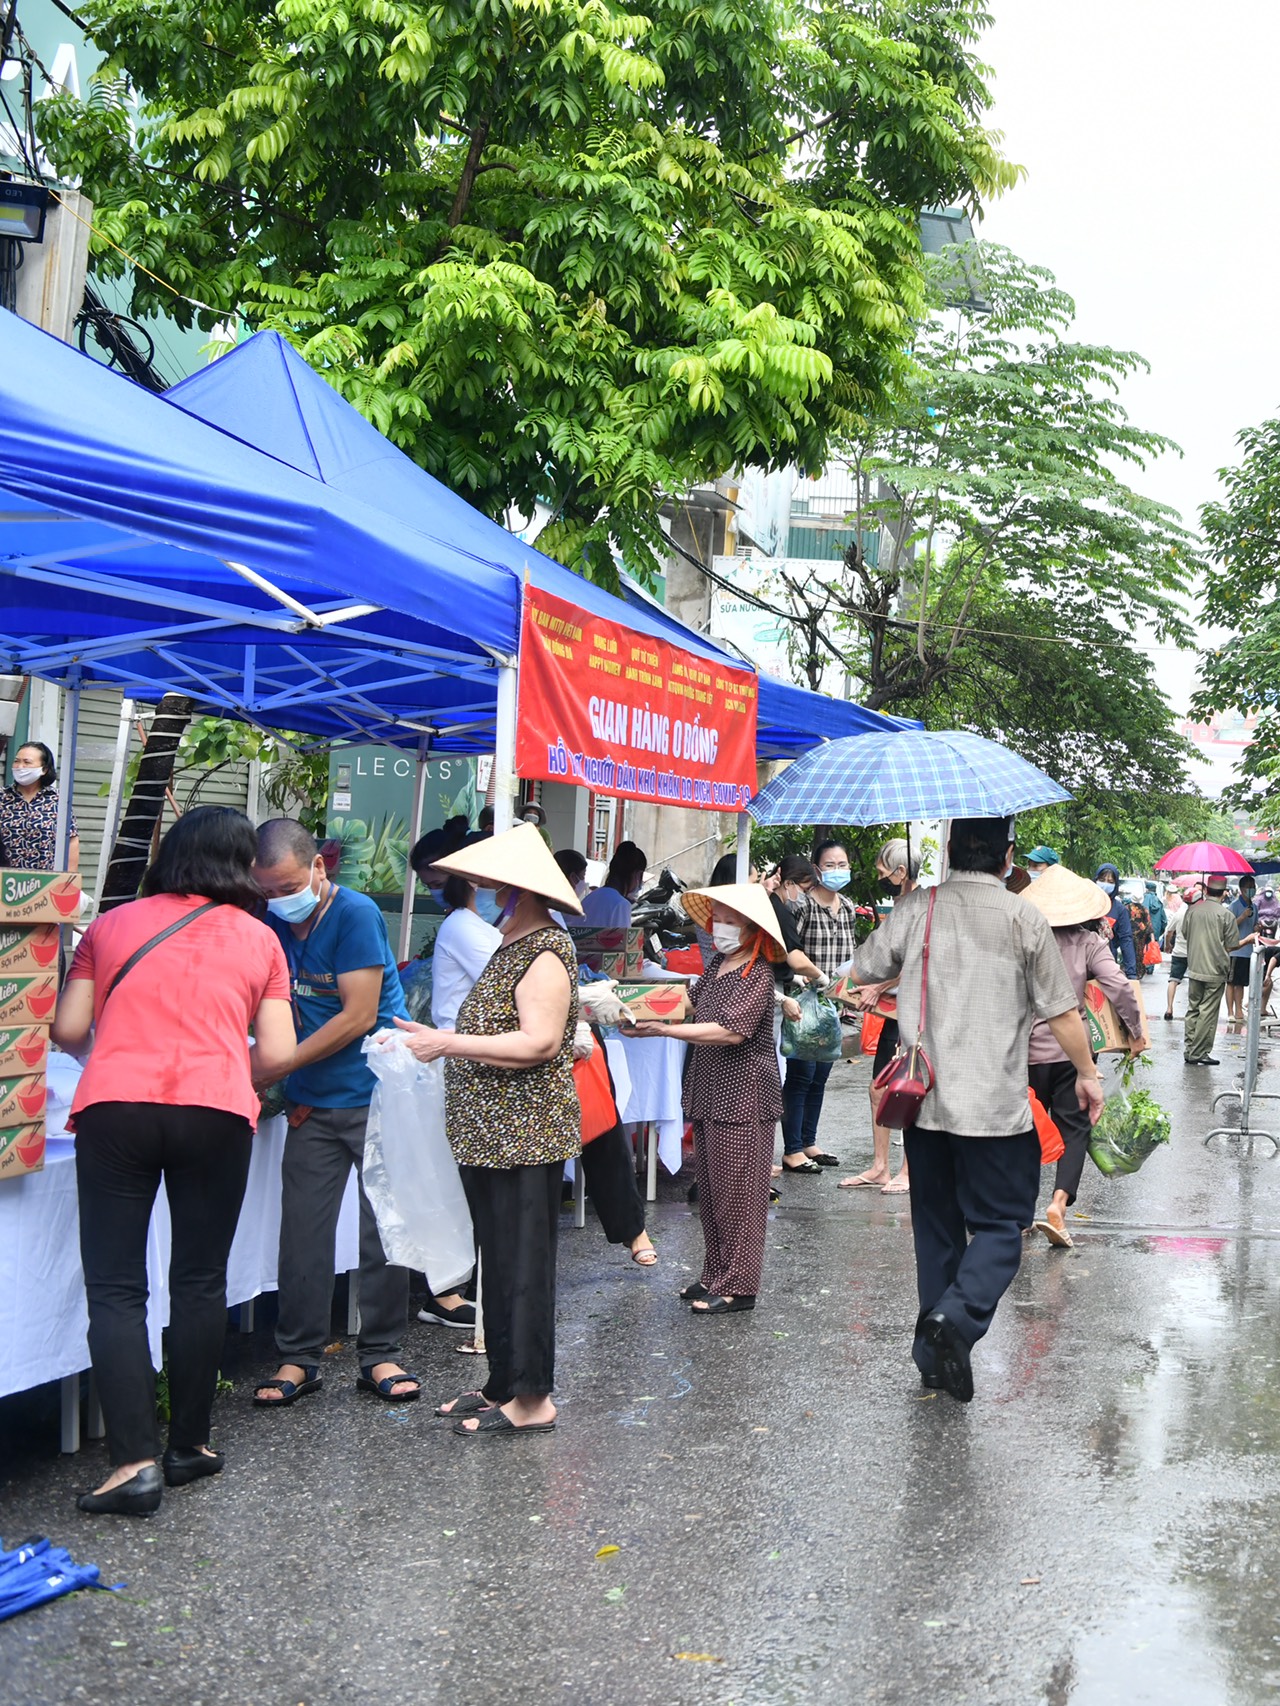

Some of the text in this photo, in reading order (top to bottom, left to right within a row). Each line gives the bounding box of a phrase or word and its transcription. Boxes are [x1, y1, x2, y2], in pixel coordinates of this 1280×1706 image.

[588, 695, 629, 746] GIAN
[631, 701, 670, 756] HÀNG
[683, 712, 719, 766] ĐỒNG
[585, 753, 616, 788] NGƯỜI
[616, 760, 636, 792] DÂN
[637, 765, 656, 796] KHÓ
[657, 769, 680, 800] KHĂN
[681, 776, 693, 803] DO
[694, 778, 712, 808] DỊCH
[712, 781, 752, 808] COVID-19
[22, 905, 33, 917] SỢI
[34, 896, 49, 912] PHỞ
[1, 948, 28, 969] SỢI PHỞ
